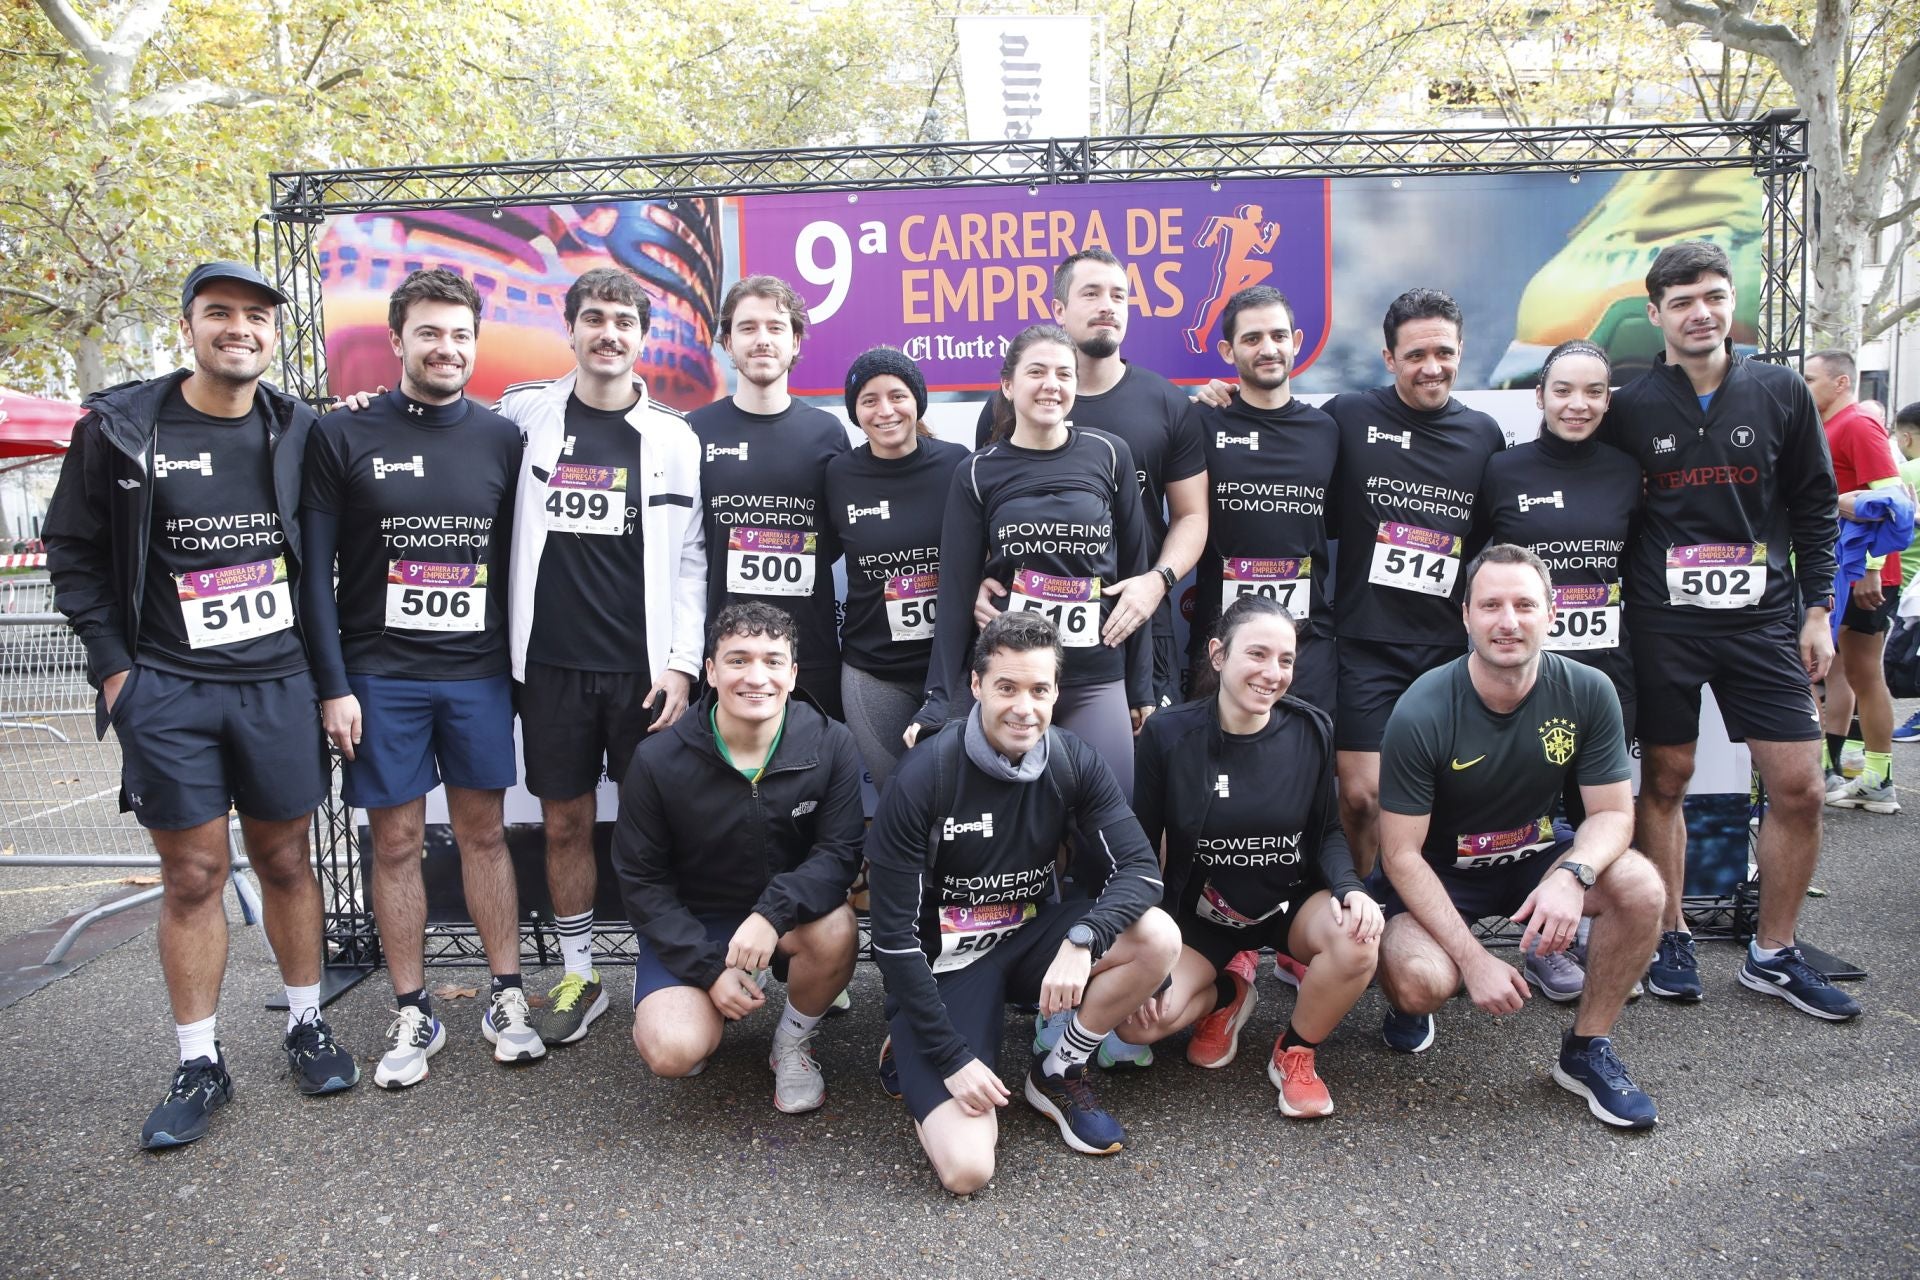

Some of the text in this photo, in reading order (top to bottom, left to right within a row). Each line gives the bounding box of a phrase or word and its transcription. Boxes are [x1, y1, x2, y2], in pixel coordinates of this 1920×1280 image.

[900, 209, 1112, 263] CARRERA
[1126, 208, 1184, 256] DE
[902, 261, 1184, 324] EMPRAS
[903, 335, 1012, 361] El Norte d
[1216, 431, 1259, 450] HORSE
[1367, 425, 1412, 450] HORSE
[706, 442, 748, 462] HORSE
[154, 452, 213, 478] HORSE
[373, 455, 424, 479] HORSE
[562, 473, 596, 481] EMPRESAS
[1654, 466, 1758, 489] TEMPERO
[1217, 482, 1325, 500] #POWERING
[1367, 476, 1474, 505] #POWERING
[546, 490, 609, 520] 499
[711, 495, 816, 510] #POWERING
[1217, 498, 1324, 516] TOMORROW
[1366, 492, 1470, 521] TOMORROW
[1518, 491, 1564, 513] HORSE
[713, 511, 814, 527] TOMORROW
[847, 500, 890, 524] HORSE
[166, 513, 280, 532] #POWERIN
[381, 516, 493, 530] #POWERING
[998, 523, 1110, 540] #POWERING
[167, 531, 285, 550] TOMORRO
[382, 534, 490, 548] TOMORROW
[758, 538, 791, 546] EMPRESAS
[1001, 541, 1108, 557] TOMORROW
[1407, 534, 1439, 546] EMPRESAS
[859, 547, 939, 567] #POWER
[1543, 556, 1617, 570] OMORRO
[1699, 551, 1735, 560] EMPRESAS
[740, 555, 802, 583] 500
[863, 562, 940, 581] TOMORR
[1252, 566, 1285, 574] EMPRESAS
[1384, 548, 1446, 583] 514
[216, 573, 257, 587] EMPRESAS
[423, 571, 459, 580] EMPRESAS
[1681, 569, 1751, 596] 502
[1043, 584, 1078, 594] EMPRESAS
[202, 590, 276, 630] 510
[401, 589, 470, 618] 506
[901, 598, 937, 628] 50
[1547, 610, 1607, 637] 505
[943, 813, 994, 841] HORSE
[1198, 831, 1302, 850] POWERING
[1491, 834, 1524, 848] EMPRESAS
[944, 860, 1055, 890] #POWERING
[973, 910, 1010, 921] EMPRESAS
